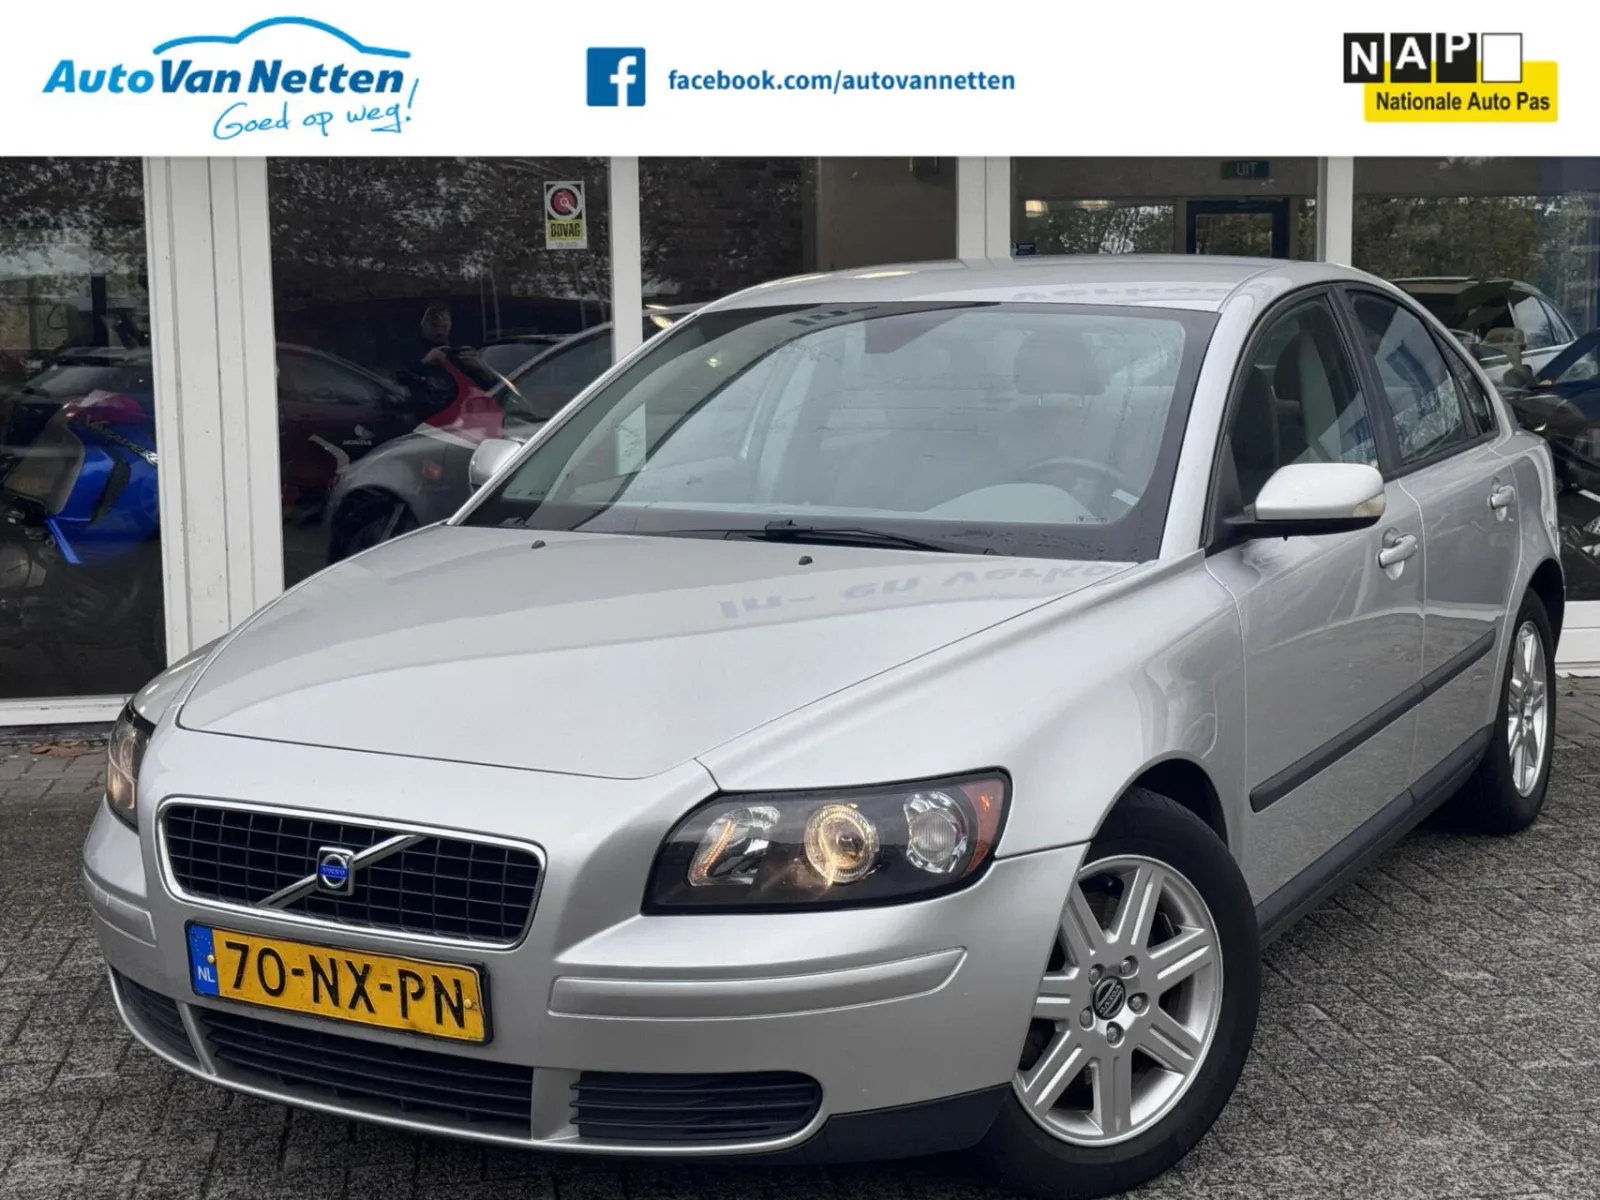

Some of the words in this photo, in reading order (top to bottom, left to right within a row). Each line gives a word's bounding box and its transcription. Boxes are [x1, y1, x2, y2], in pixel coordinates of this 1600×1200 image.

[1236, 161, 1258, 177] UIT
[550, 222, 581, 238] BOVAG
[197, 964, 215, 984] NL
[224, 940, 466, 1030] 70-NX-PN
